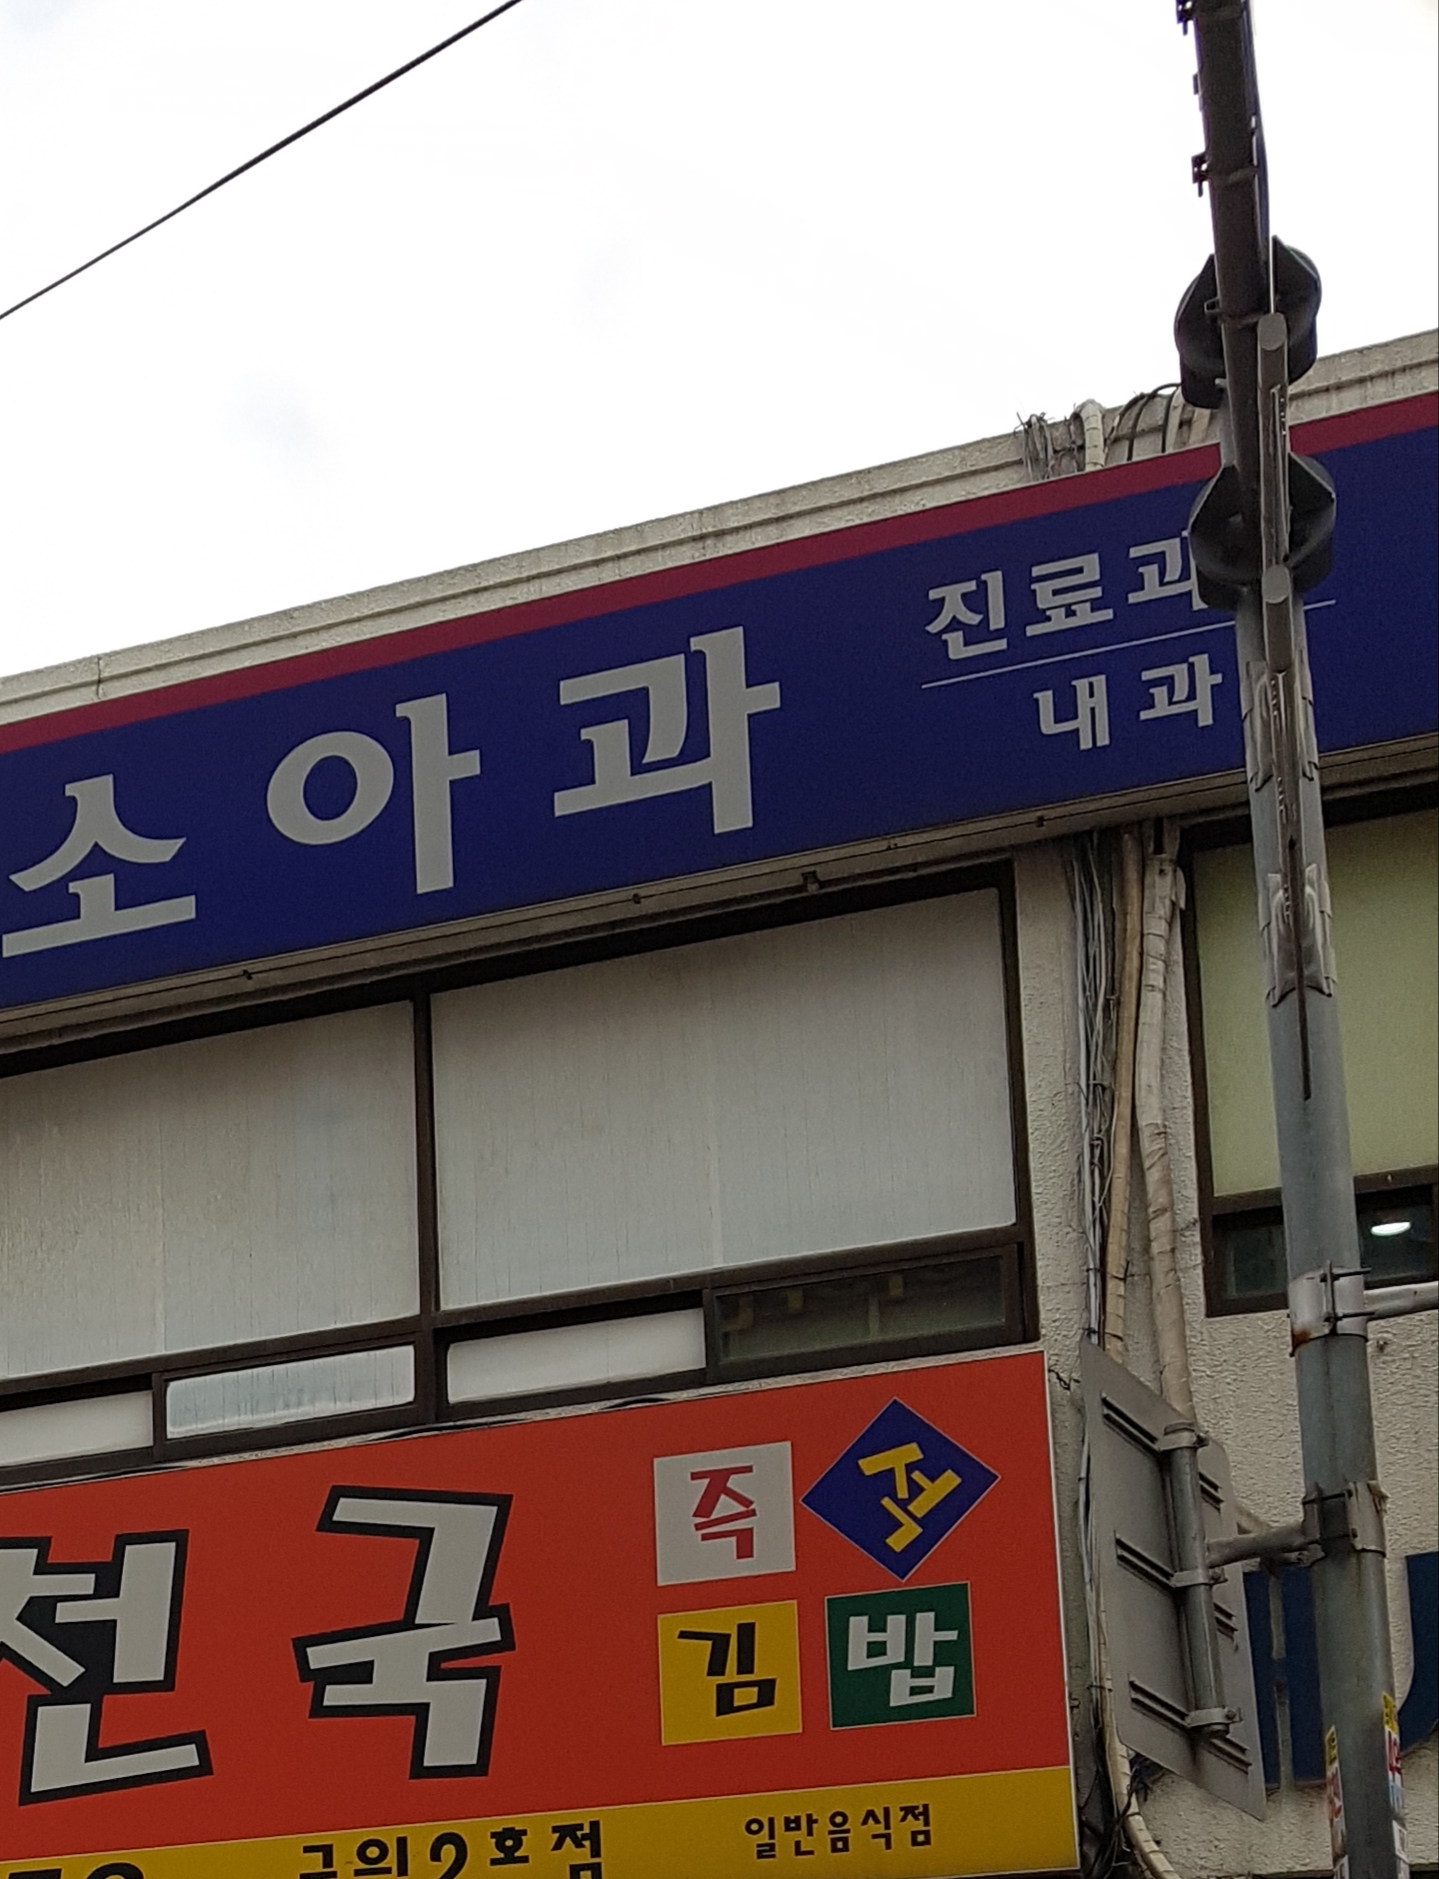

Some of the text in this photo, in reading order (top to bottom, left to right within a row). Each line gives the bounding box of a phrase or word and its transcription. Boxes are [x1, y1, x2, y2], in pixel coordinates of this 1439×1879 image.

[1033, 653, 1223, 751] 내과
[677, 1611, 959, 1718] 김밥
[744, 1803, 933, 1860] 일반음식점
